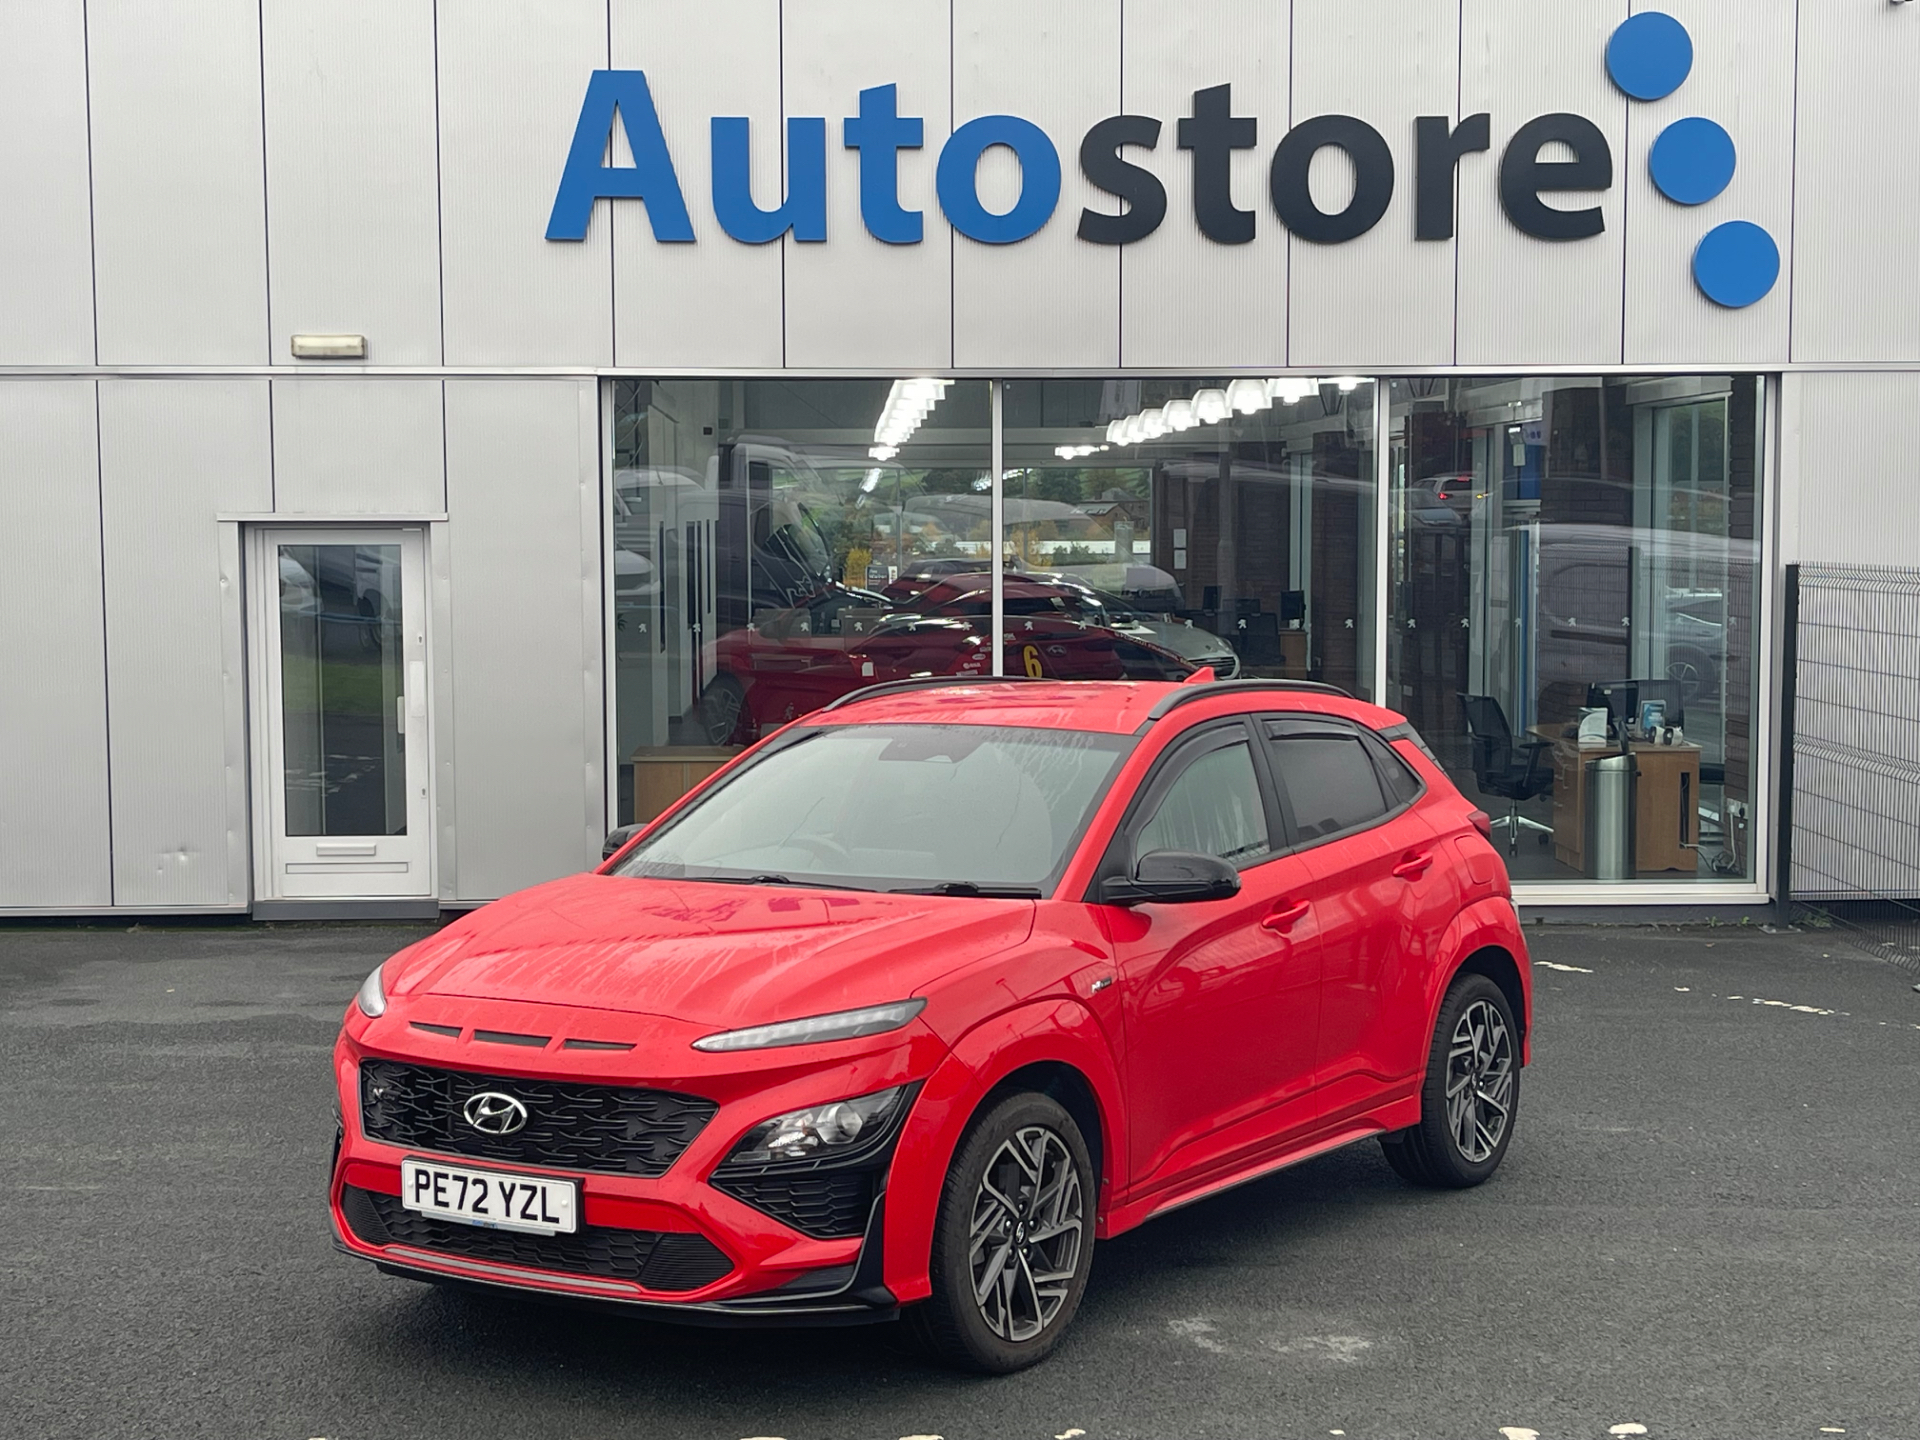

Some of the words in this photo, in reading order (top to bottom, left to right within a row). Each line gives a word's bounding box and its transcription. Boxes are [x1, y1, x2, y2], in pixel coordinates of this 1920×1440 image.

[545, 70, 1613, 244] Autostore
[1023, 645, 1043, 678] 6
[414, 1168, 489, 1215] PE72
[498, 1181, 560, 1225] YZL
